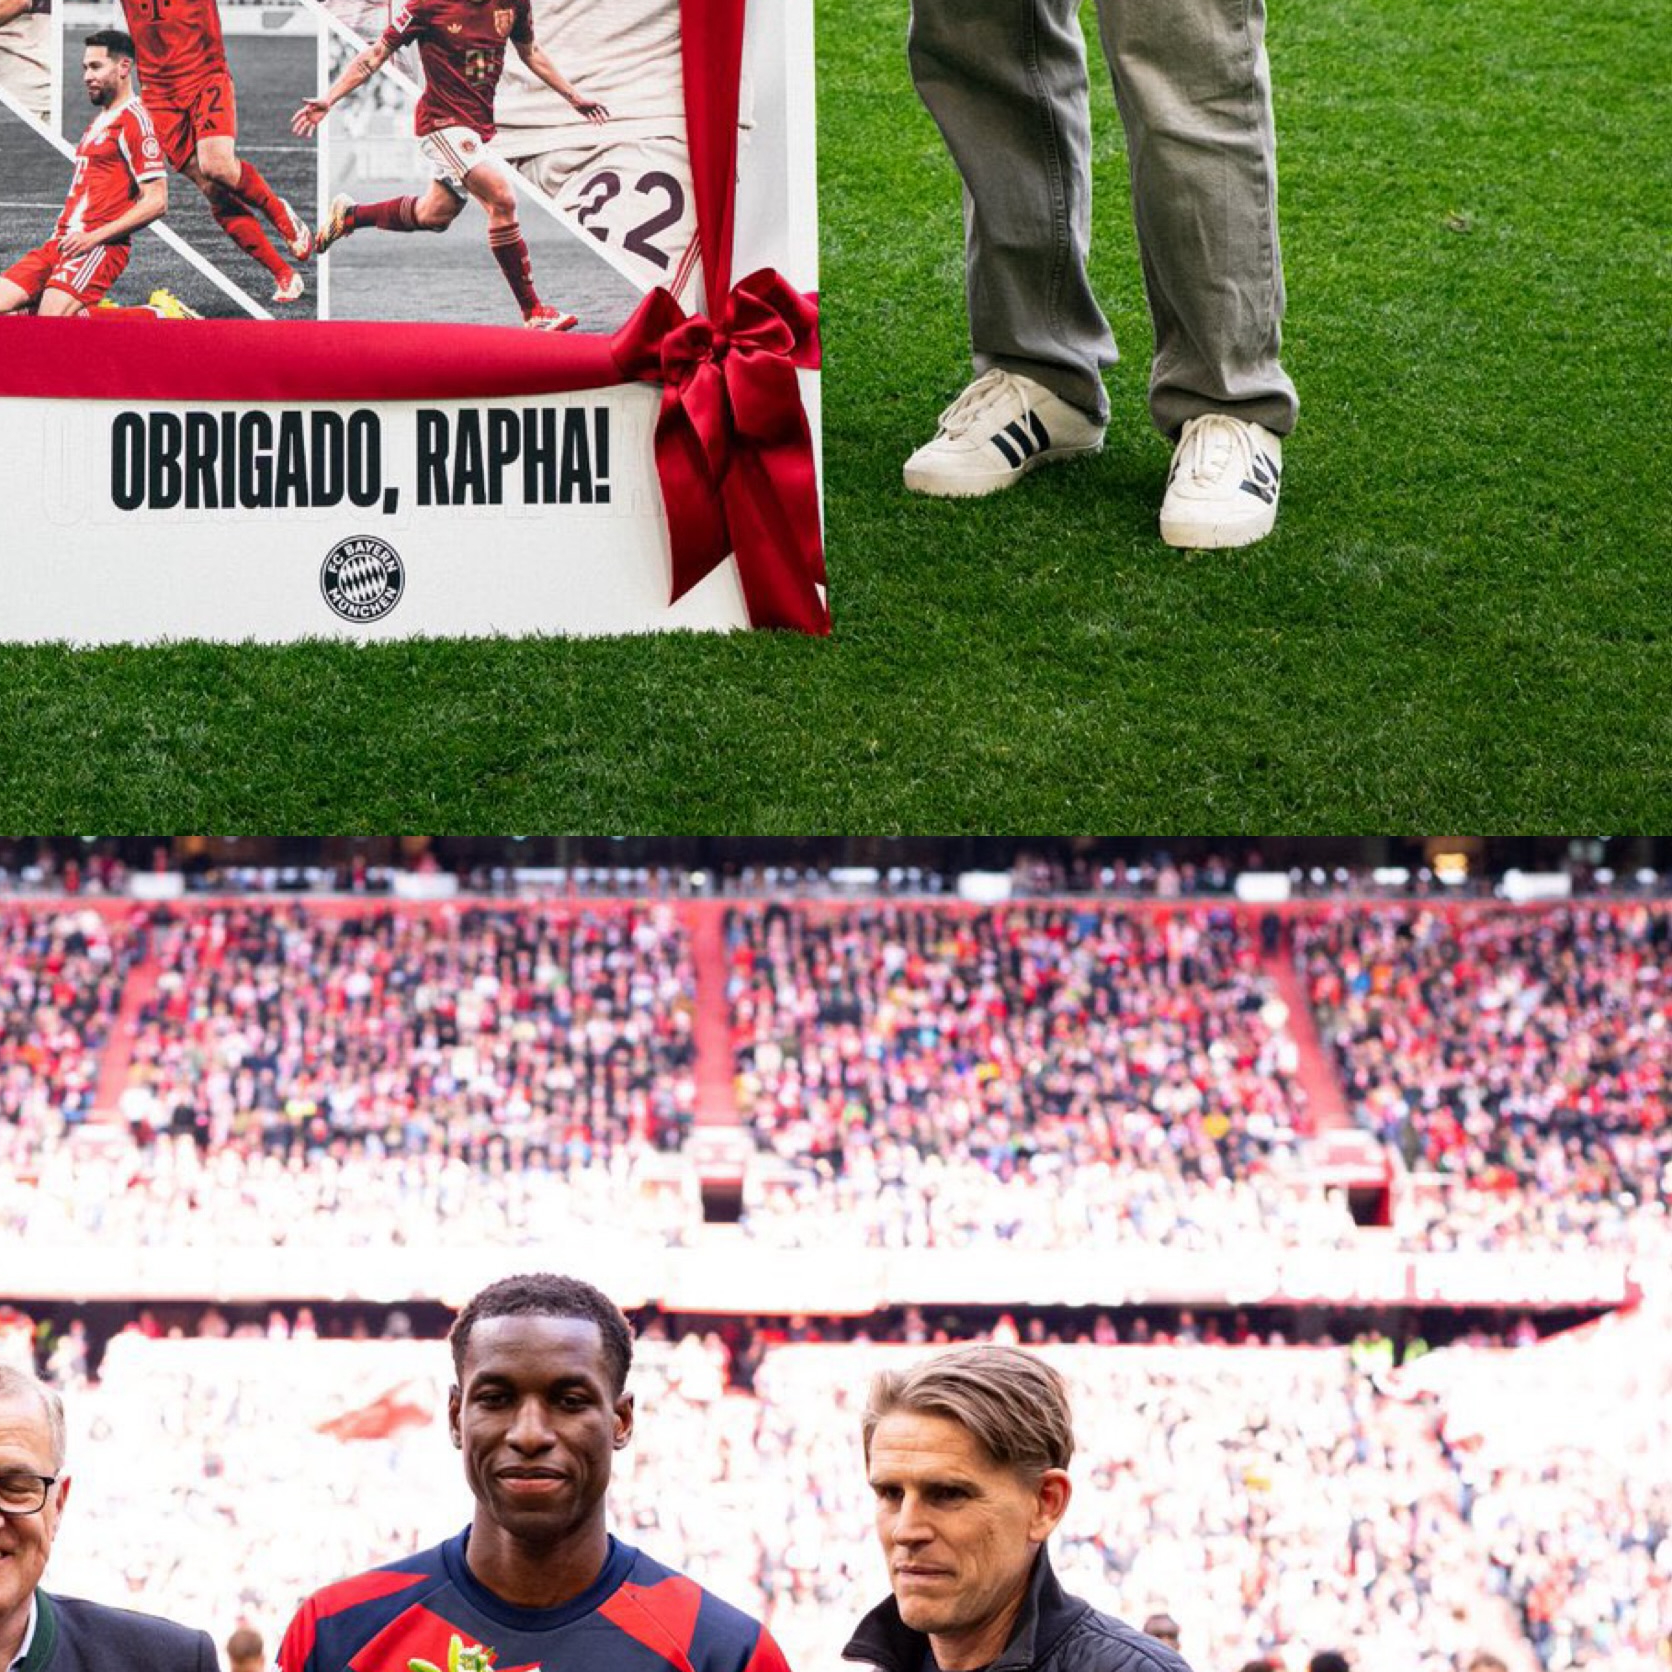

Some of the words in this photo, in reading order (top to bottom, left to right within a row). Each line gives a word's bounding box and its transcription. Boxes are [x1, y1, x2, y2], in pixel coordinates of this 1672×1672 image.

[577, 170, 686, 271] 22
[110, 407, 400, 515] OBRIGADO,
[416, 405, 611, 506] RAPHA!
[344, 541, 398, 573] BAYERN
